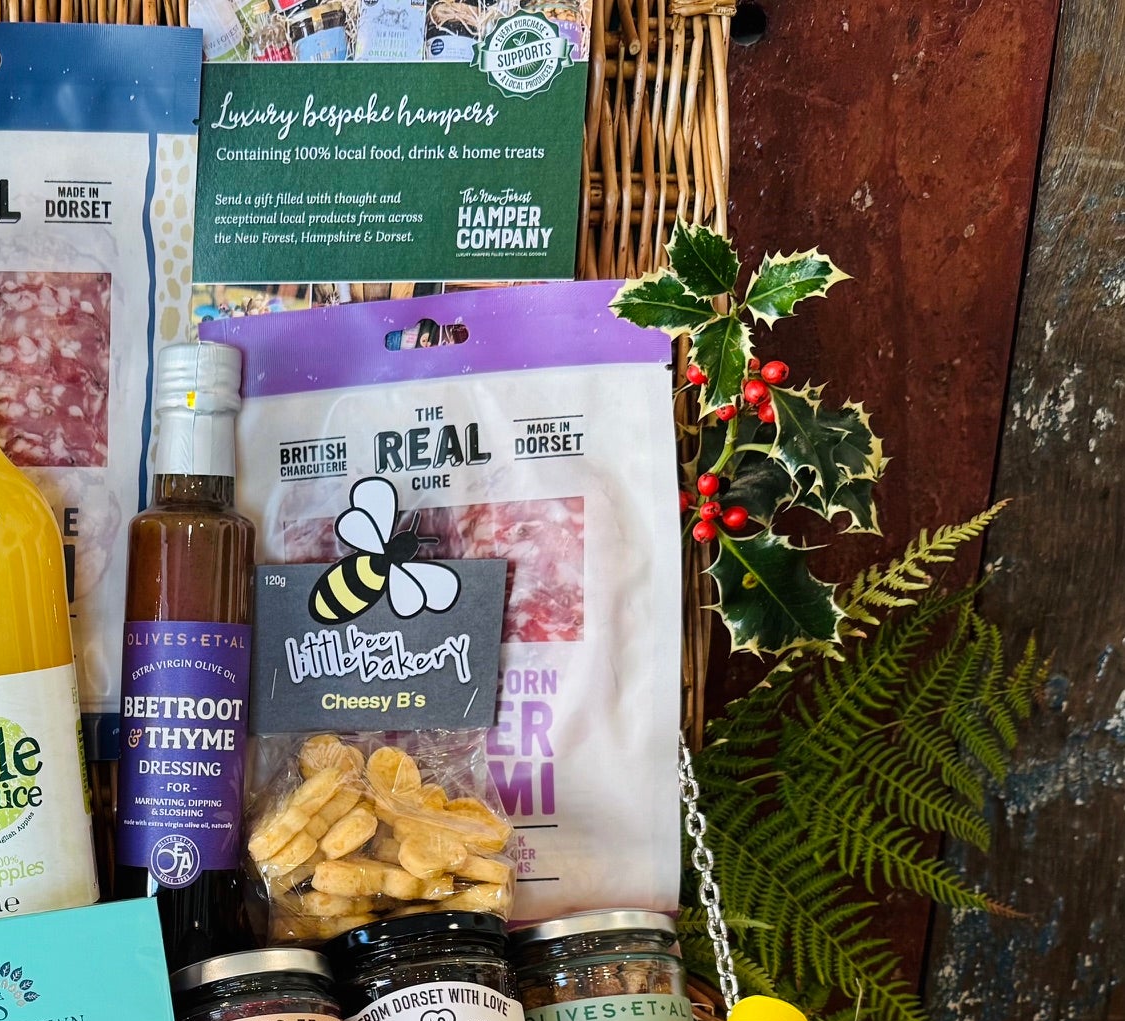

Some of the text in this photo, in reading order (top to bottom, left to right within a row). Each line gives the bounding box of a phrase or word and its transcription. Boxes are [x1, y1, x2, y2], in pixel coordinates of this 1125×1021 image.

[498, 42, 551, 67] SUPPORTS
[212, 92, 498, 140] Luxury bespoke hampers
[216, 146, 544, 165] Containing 100% local food, drink & home treats
[45, 201, 112, 219] DORSET
[214, 211, 423, 226] exceptional local products from across
[458, 206, 541, 227] HAMPER
[214, 230, 414, 245] the New Forest, Hampshire & Dorset.
[457, 227, 553, 249] COMPANY
[415, 406, 443, 422] THE
[280, 442, 347, 465] BRITISH
[374, 423, 491, 474] REAL
[514, 433, 584, 455] DORSET
[280, 460, 347, 477] CHARCUTERIE
[412, 475, 451, 491] CURE
[264, 575, 286, 588] 120g
[349, 628, 391, 652] bee
[286, 632, 469, 682] little bakery
[132, 660, 236, 683] EXTRA VIRGIN OLIVE OIL
[124, 696, 242, 721] BEETROOT
[322, 693, 392, 712] Cheesy
[128, 727, 235, 751] & THYME
[139, 760, 221, 776] DRESSING
[135, 797, 222, 808] MARINATING, DIPPING
